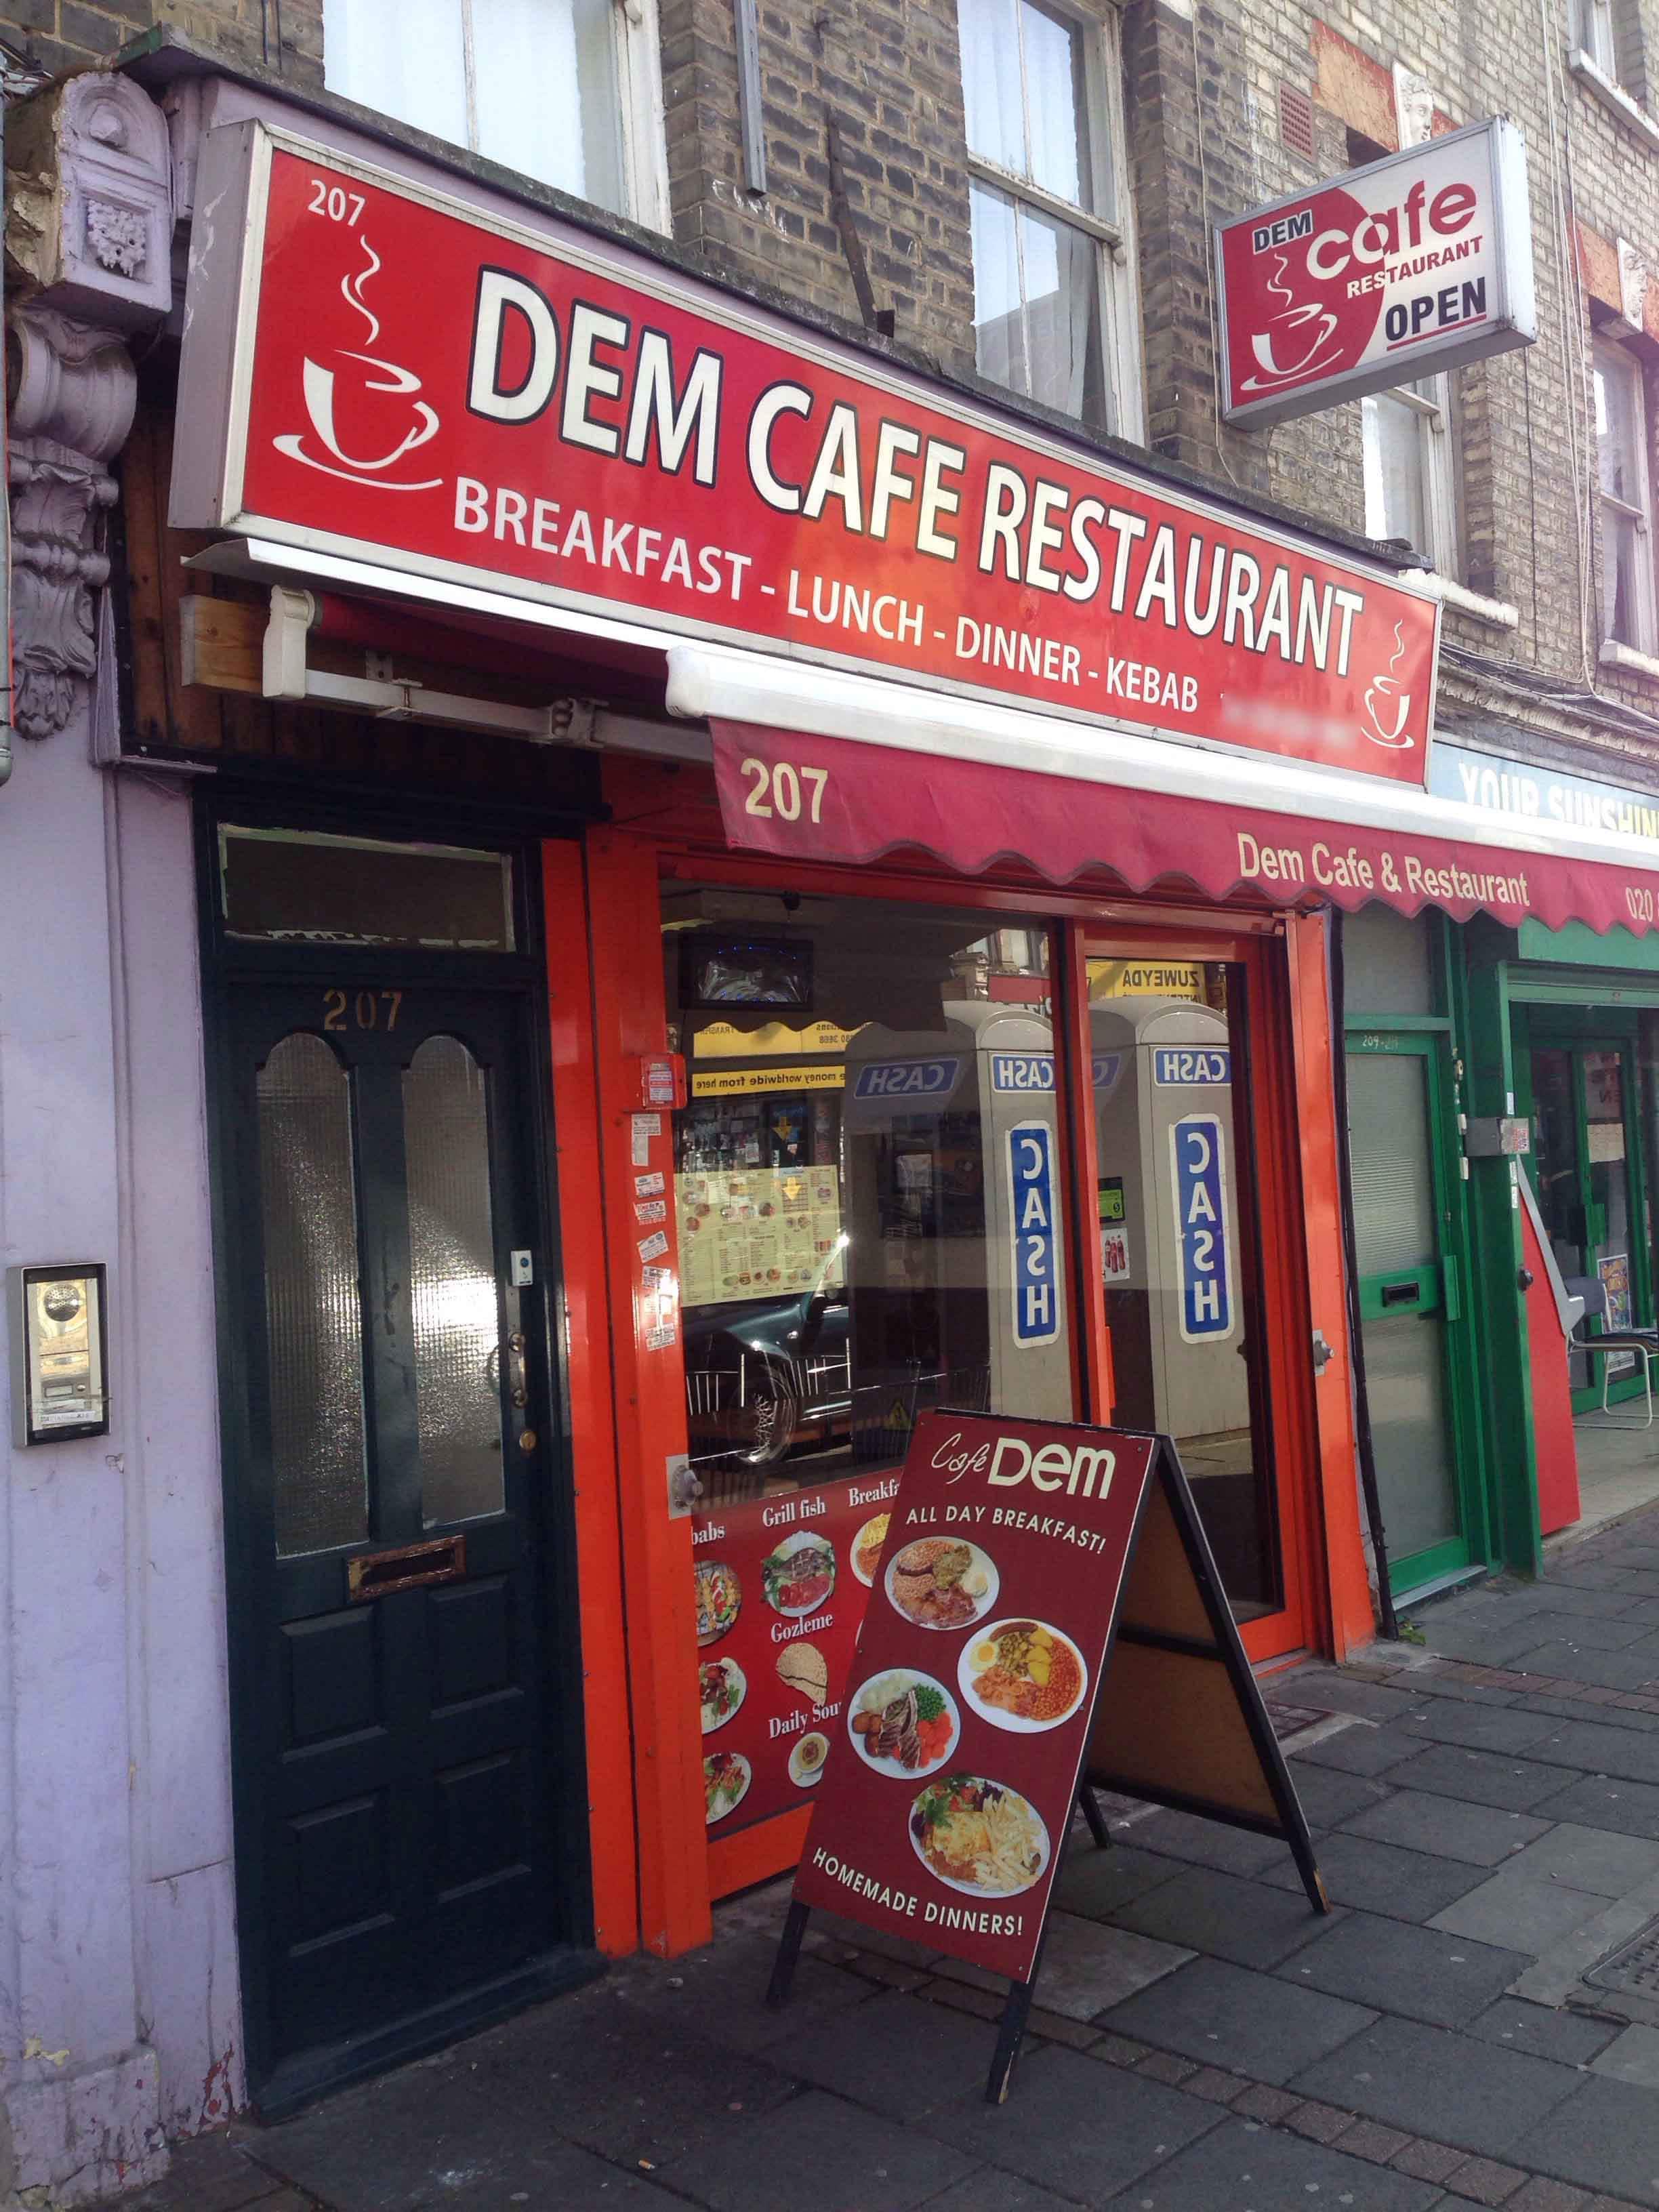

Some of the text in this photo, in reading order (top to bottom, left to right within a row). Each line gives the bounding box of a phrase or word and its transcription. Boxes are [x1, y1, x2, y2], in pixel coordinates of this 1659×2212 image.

[307, 179, 367, 228] 207
[1252, 180, 1477, 280] DEM cafe
[1346, 235, 1483, 300] RESTAURANT
[1385, 276, 1486, 342] OPEN
[465, 264, 1364, 678] DEM CAFE RESTAURANT
[453, 476, 752, 602] BREAKFAST
[787, 568, 925, 647] LUNCH
[954, 615, 1082, 687] DINNER
[1105, 656, 1199, 714] KEBAB
[741, 758, 829, 823] 207
[1458, 761, 1659, 840] YOUR SUNSHIN
[1237, 832, 1531, 907] Dem Cafe & Restaurant
[1626, 886, 1654, 922] 020
[322, 988, 403, 1031] 207
[848, 1479, 899, 1507] Breakfa
[987, 1436, 1116, 1500] Dem
[691, 1521, 725, 1546] babs
[762, 1496, 827, 1527] Grill fish
[905, 1504, 1107, 1555] ALL DAY BREAKFAST!
[771, 1613, 834, 1643] Gozleme
[769, 1701, 842, 1739] Daily Sou
[813, 1847, 1023, 1936] HOMEMADE DINNERS!
